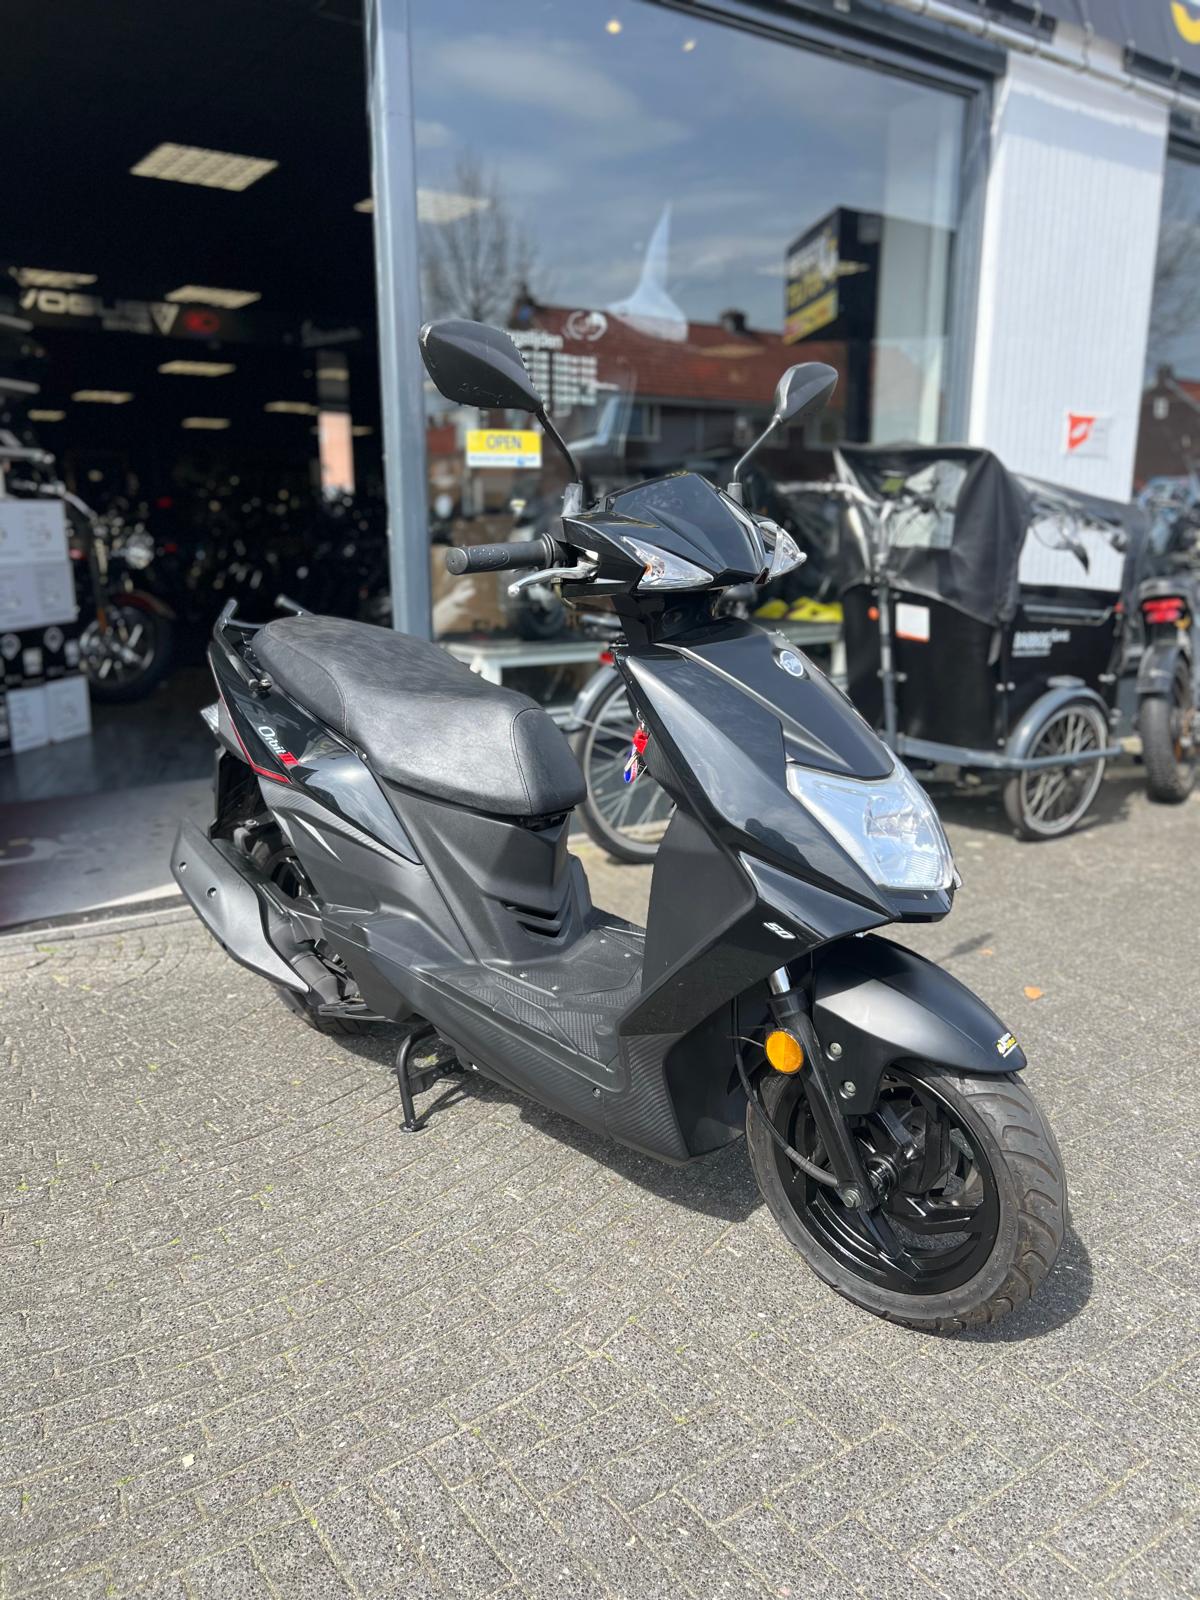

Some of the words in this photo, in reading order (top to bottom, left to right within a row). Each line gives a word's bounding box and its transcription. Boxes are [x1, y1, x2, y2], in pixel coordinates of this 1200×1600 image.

[486, 433, 522, 449] OPEN
[258, 725, 287, 755] Orbit
[762, 921, 797, 940] 50
